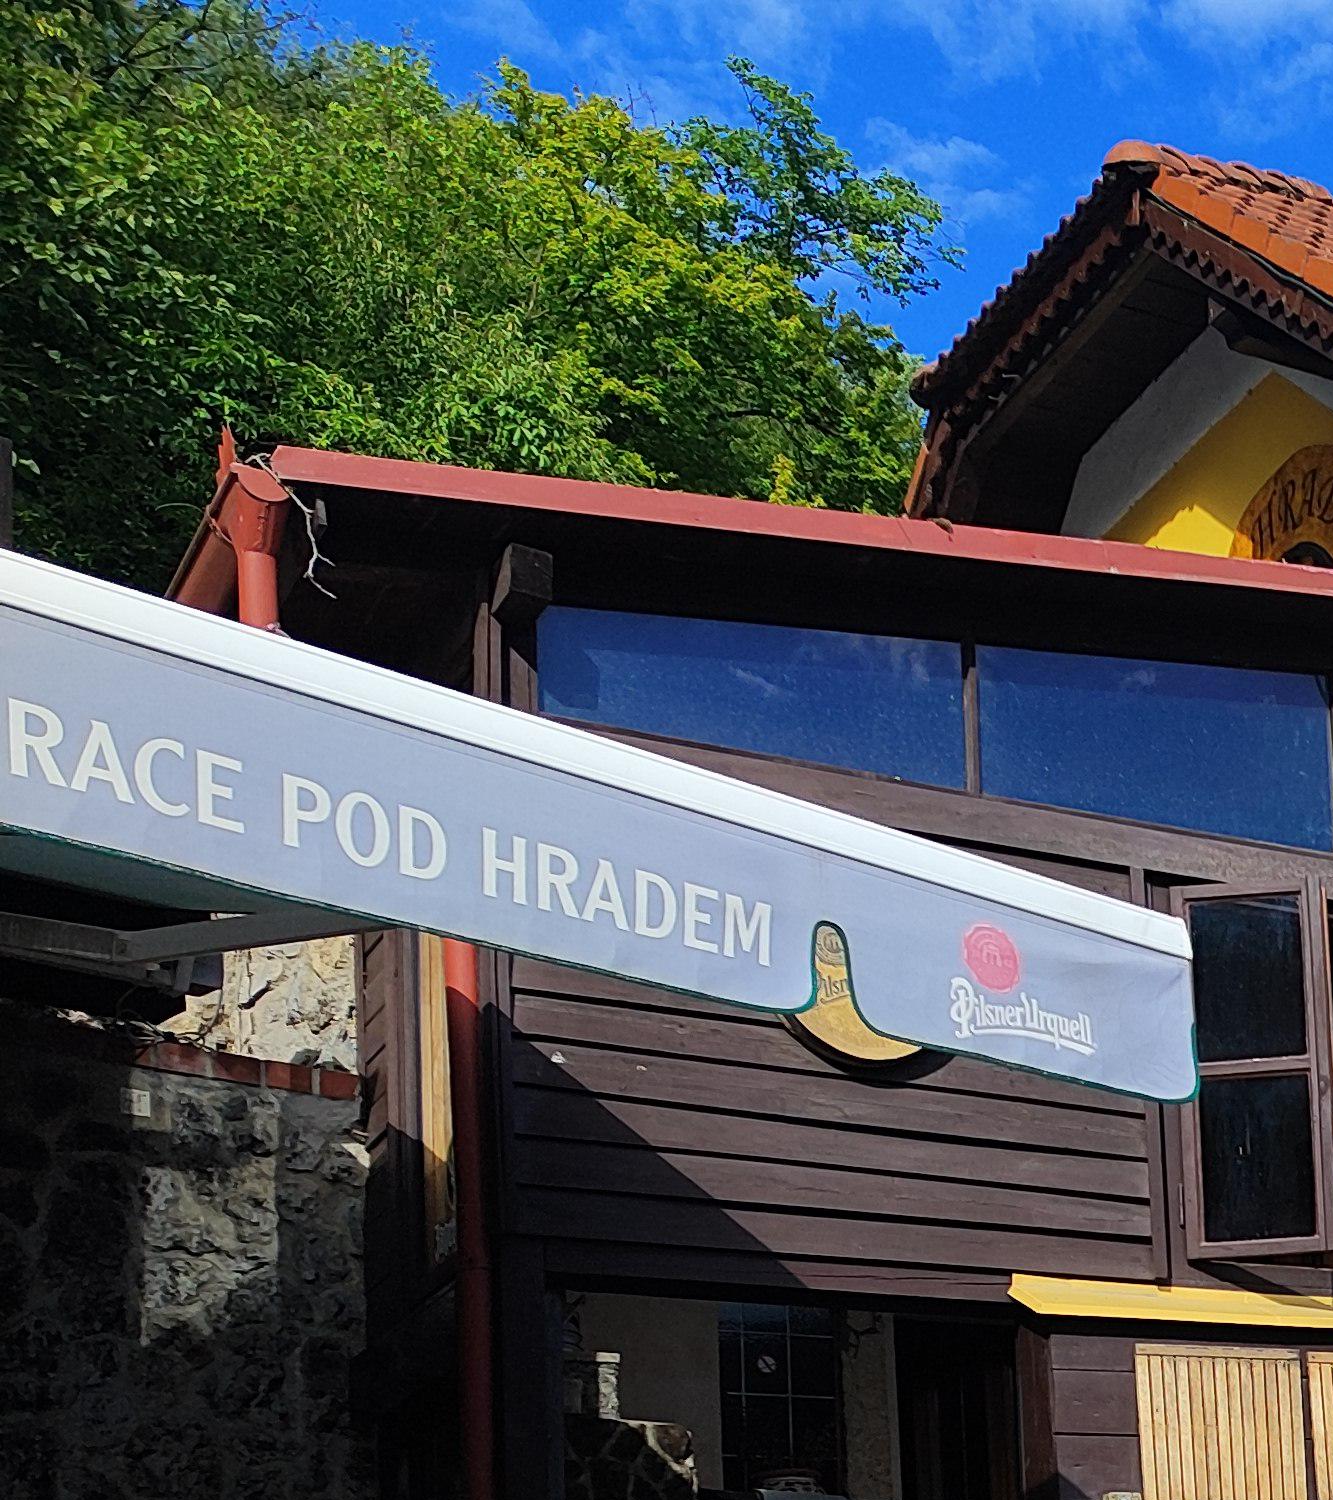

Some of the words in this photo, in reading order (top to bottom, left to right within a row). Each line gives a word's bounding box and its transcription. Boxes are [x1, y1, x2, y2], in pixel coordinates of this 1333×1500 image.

[8, 697, 246, 834] RACE
[282, 773, 447, 879] POD
[481, 826, 773, 967] HRADEM
[950, 976, 1024, 1038] Pilsner
[1019, 992, 1094, 1050] Urquell
